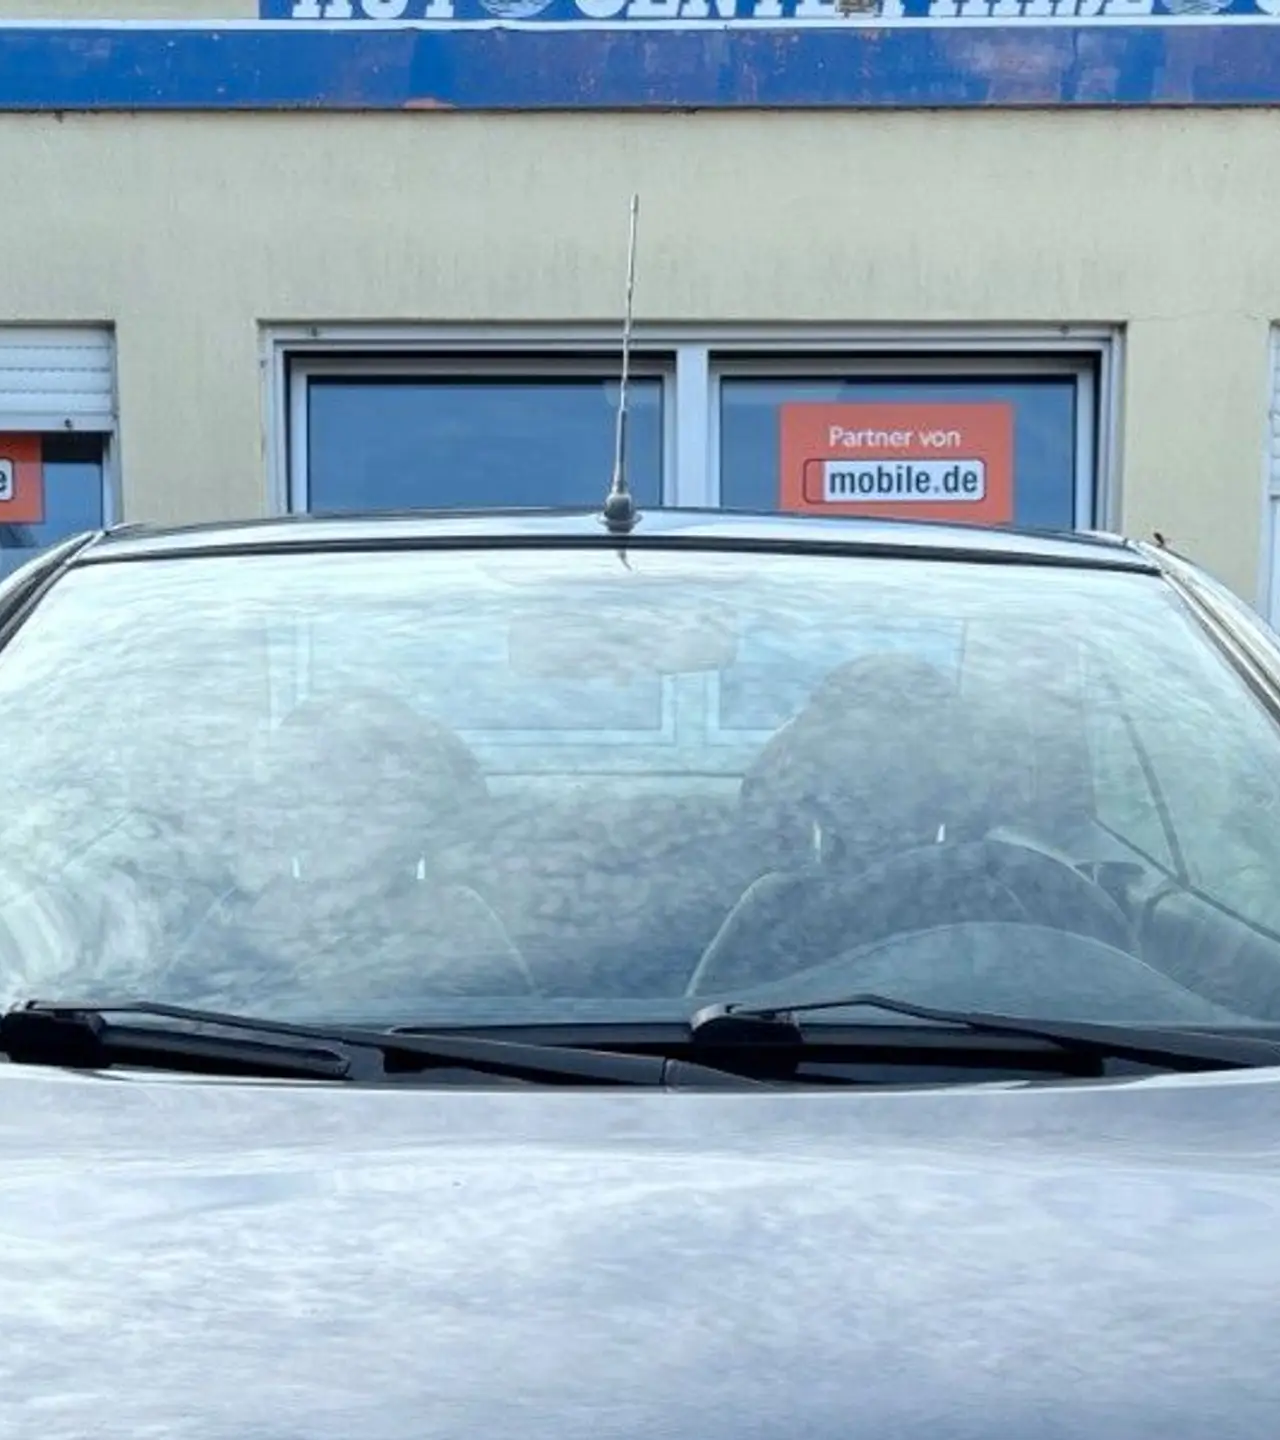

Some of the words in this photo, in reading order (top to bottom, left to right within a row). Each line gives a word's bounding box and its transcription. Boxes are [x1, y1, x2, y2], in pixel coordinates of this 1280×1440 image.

[828, 425, 913, 448] Partner
[919, 429, 962, 448] von
[829, 464, 979, 494] mobile.de
